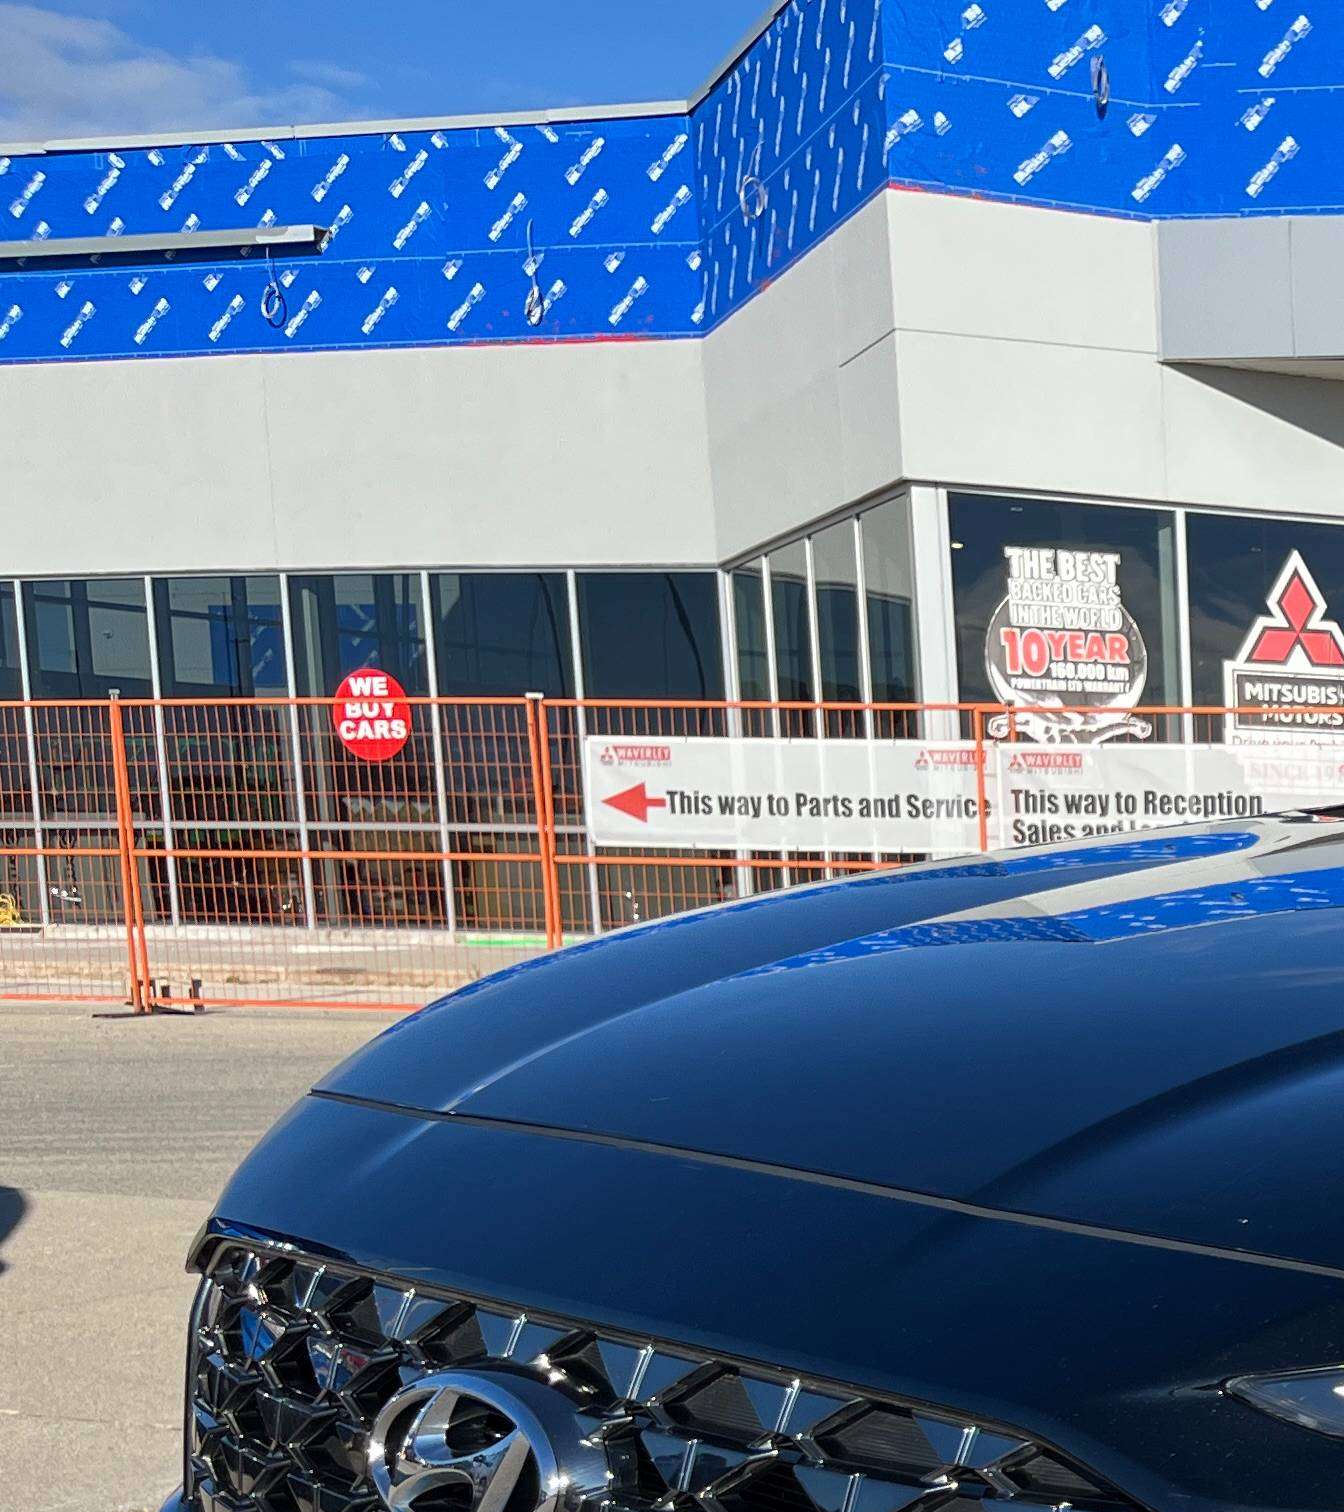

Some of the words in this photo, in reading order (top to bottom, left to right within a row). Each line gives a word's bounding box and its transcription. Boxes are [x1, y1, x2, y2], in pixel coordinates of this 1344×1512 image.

[1004, 546, 1055, 579] THE
[1057, 549, 1121, 584] BEST
[1000, 627, 1050, 677] 10
[1047, 630, 1131, 665] YEAR
[348, 676, 389, 697] WE
[344, 699, 395, 718] BUY
[340, 719, 407, 740] CARS
[617, 746, 670, 761] WAVERLEY
[1025, 754, 1082, 768] WAVERLEY
[666, 789, 713, 816] This
[718, 795, 763, 819] way
[767, 792, 789, 816] to
[796, 793, 854, 818] Parts
[859, 794, 901, 818] and
[907, 794, 992, 819] Service
[1011, 789, 1059, 815] This
[1064, 793, 1110, 817] way
[1115, 790, 1138, 815] to
[1013, 818, 1076, 844] Sales
